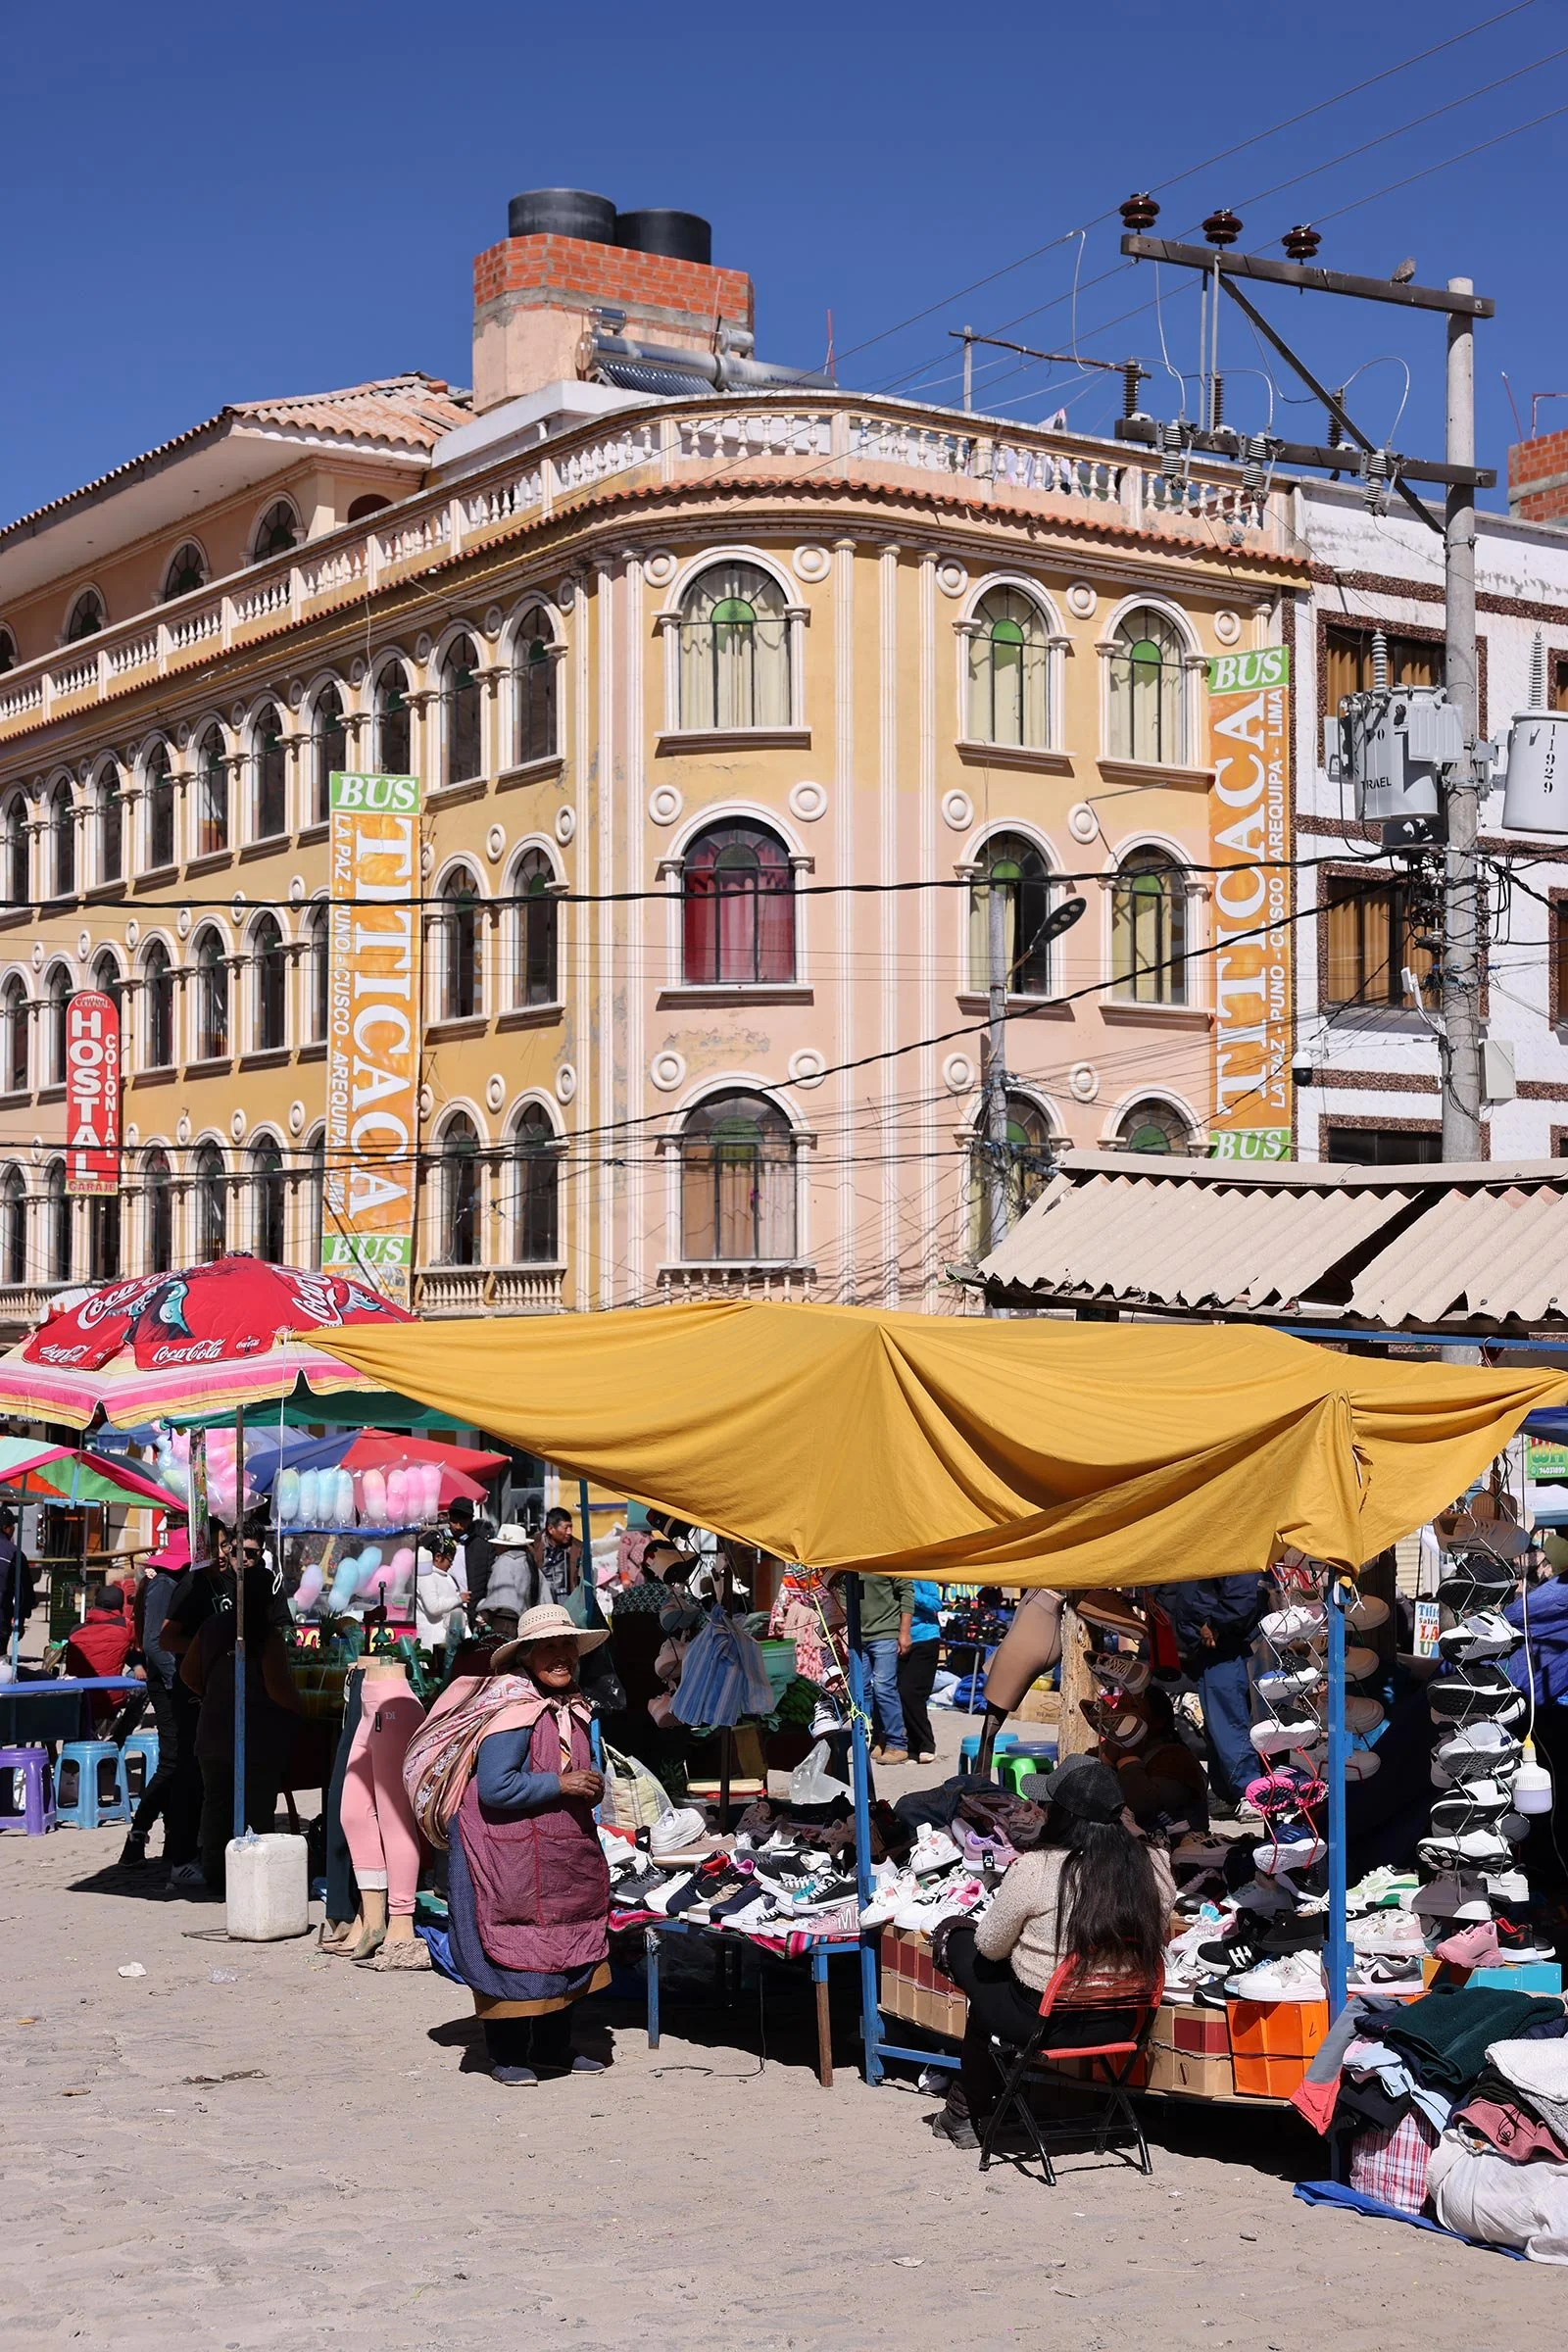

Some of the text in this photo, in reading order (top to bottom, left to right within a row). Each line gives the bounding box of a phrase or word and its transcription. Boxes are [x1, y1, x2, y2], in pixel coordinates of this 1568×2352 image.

[1212, 649, 1283, 690] BUS
[1267, 689, 1284, 737] LIMA
[1544, 723, 1555, 794] 11929
[335, 775, 416, 810] BUS
[1267, 760, 1284, 861] AREQUIPA
[334, 814, 352, 839] LA
[334, 843, 352, 882] PAZ
[334, 896, 352, 951] PUNO
[1214, 691, 1267, 1115] TITICACA
[1268, 877, 1285, 948] CUSCO
[333, 967, 351, 1036] CUSCO
[1269, 965, 1286, 1021] PUNO
[349, 816, 412, 1219] TITICACA
[1270, 1038, 1286, 1078] PAZ
[69, 1008, 104, 1179] HOSTAL
[104, 1033, 118, 1158] COLONIAL
[329, 1051, 350, 1152] AREQUIPA
[1270, 1080, 1286, 1108] LA
[1214, 1130, 1283, 1160] BUS
[69, 1181, 116, 1193] GARAJE
[328, 1168, 345, 1215] LIMA
[329, 1236, 404, 1264] BUS
[152, 1339, 225, 1365] Coca-Cola
